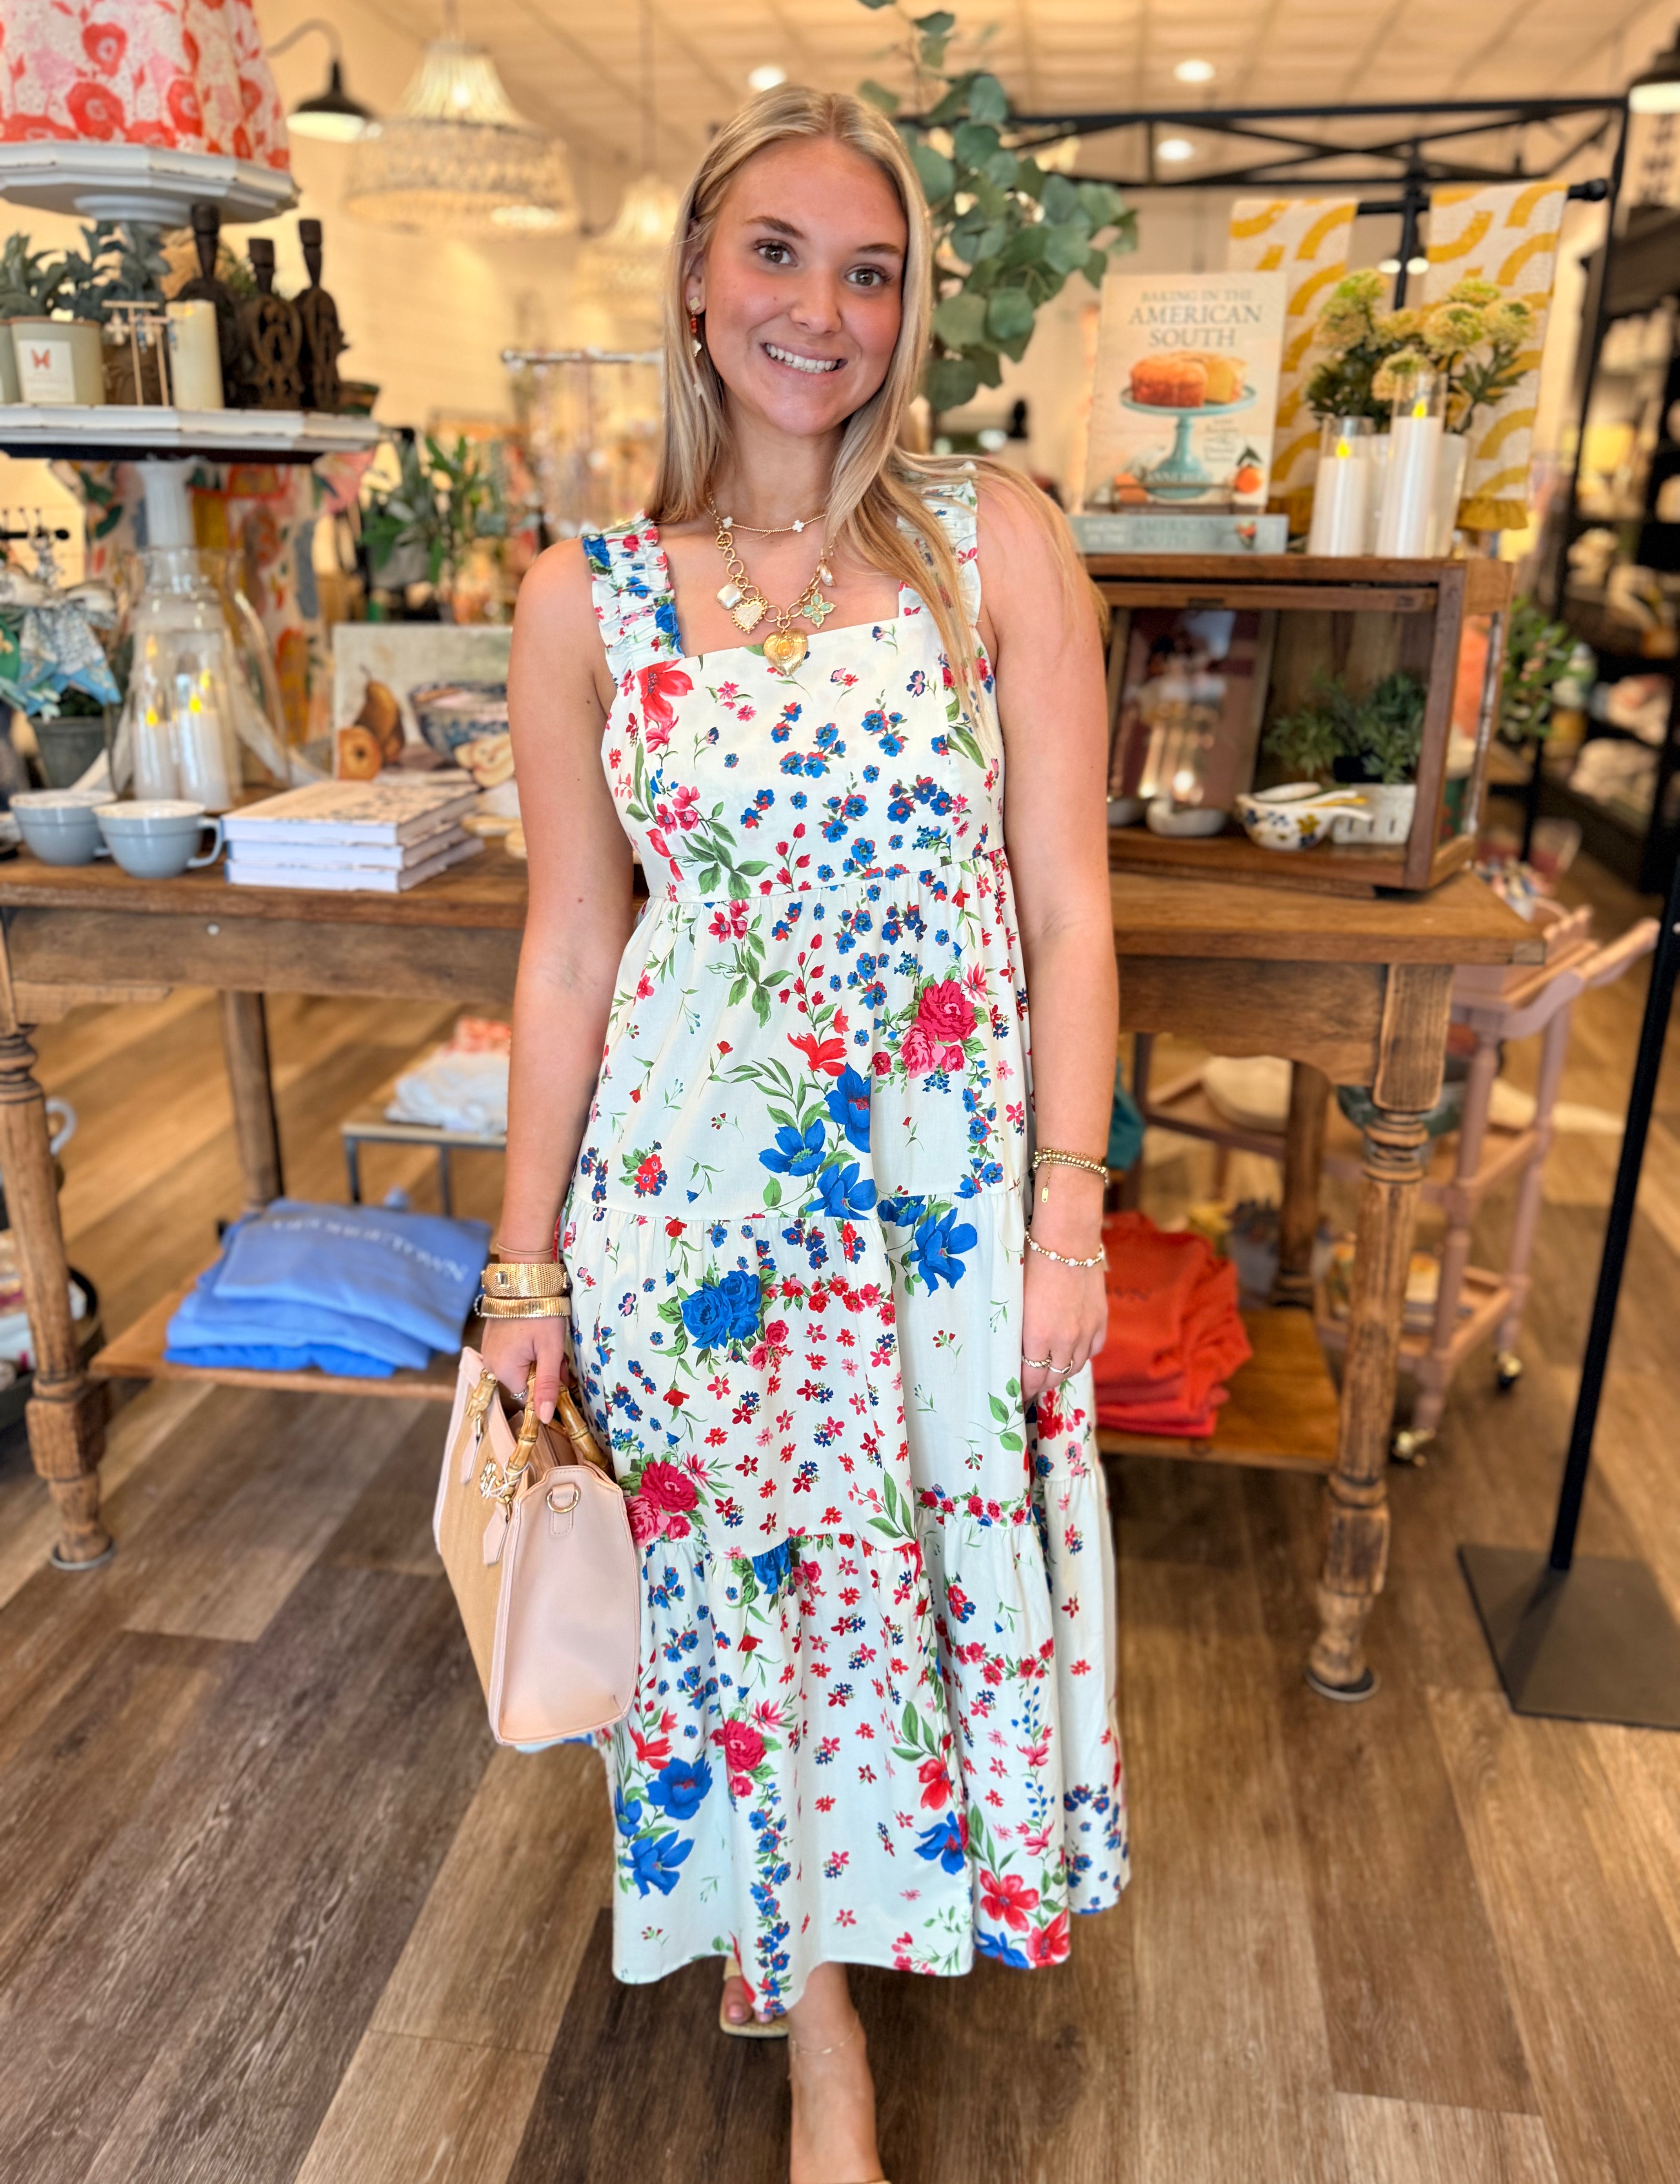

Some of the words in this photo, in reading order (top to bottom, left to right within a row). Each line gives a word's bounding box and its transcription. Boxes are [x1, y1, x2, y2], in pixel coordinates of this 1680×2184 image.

[1141, 290, 1196, 302] BAKING
[1202, 289, 1218, 301] IN
[1224, 289, 1252, 301] THE
[1128, 304, 1262, 325] AMERICAN
[1148, 328, 1236, 347] SOUTH
